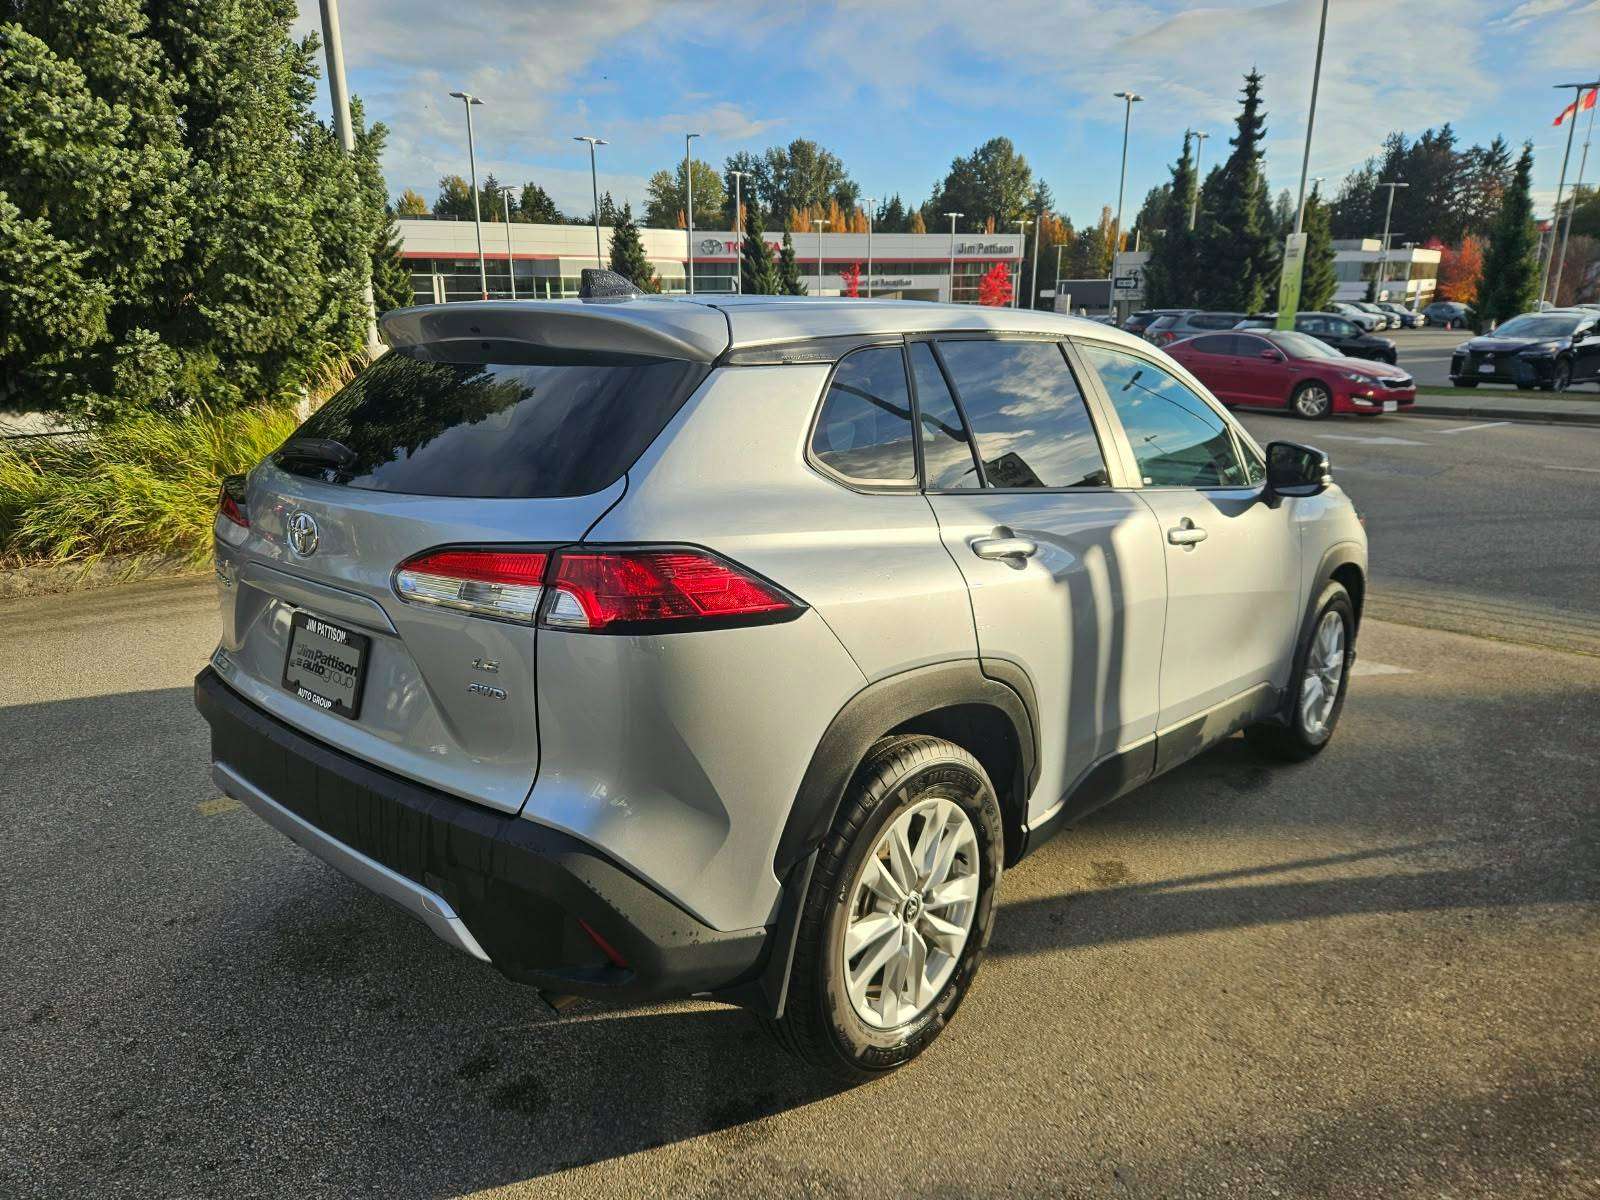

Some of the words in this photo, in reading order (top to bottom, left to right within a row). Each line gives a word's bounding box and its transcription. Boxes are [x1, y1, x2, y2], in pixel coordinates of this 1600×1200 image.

[958, 242, 976, 255] Jim
[976, 242, 1014, 255] Pattison
[306, 618, 317, 632] JIM
[297, 643, 315, 660] Jim
[314, 648, 358, 677] Pattison
[297, 687, 312, 702] AUTO
[311, 693, 333, 710] GROUP
[467, 682, 507, 700] AWD
